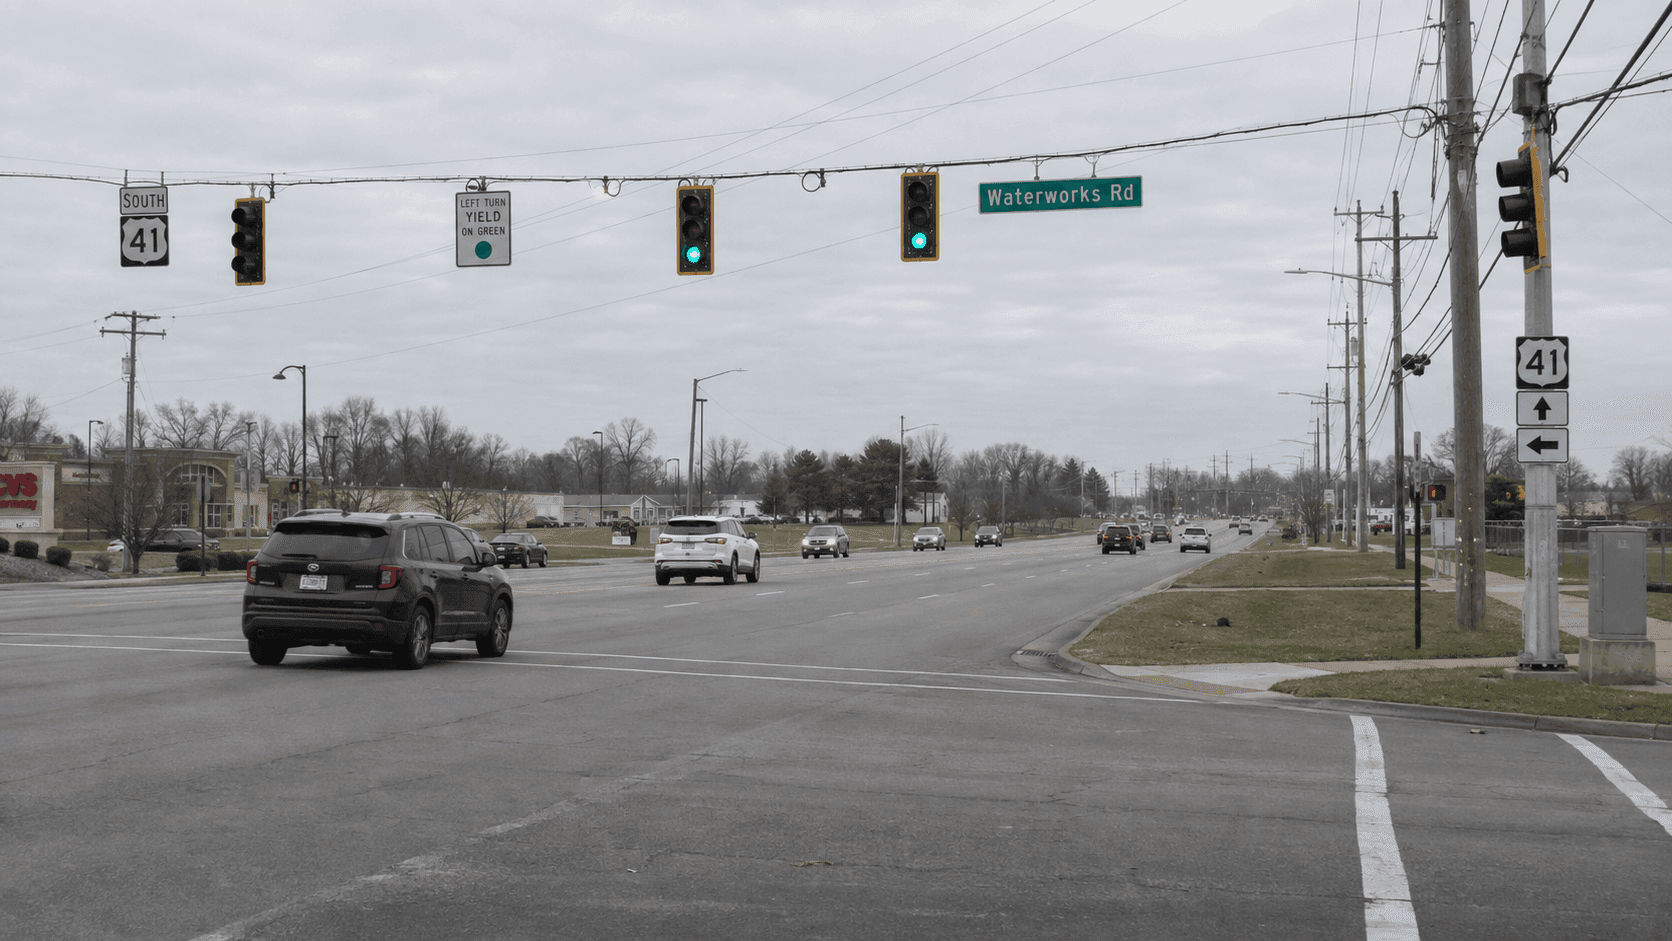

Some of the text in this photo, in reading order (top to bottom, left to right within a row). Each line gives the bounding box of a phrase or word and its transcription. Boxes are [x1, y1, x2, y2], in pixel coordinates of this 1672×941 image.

[123, 193, 165, 208] SOUTH
[988, 183, 1133, 207] Waterworks Rd
[460, 198, 506, 208] LEFT TURN
[466, 211, 501, 222] YIELD
[461, 226, 505, 236] ON GREEN
[129, 228, 158, 253] 41
[1525, 349, 1557, 375] 41
